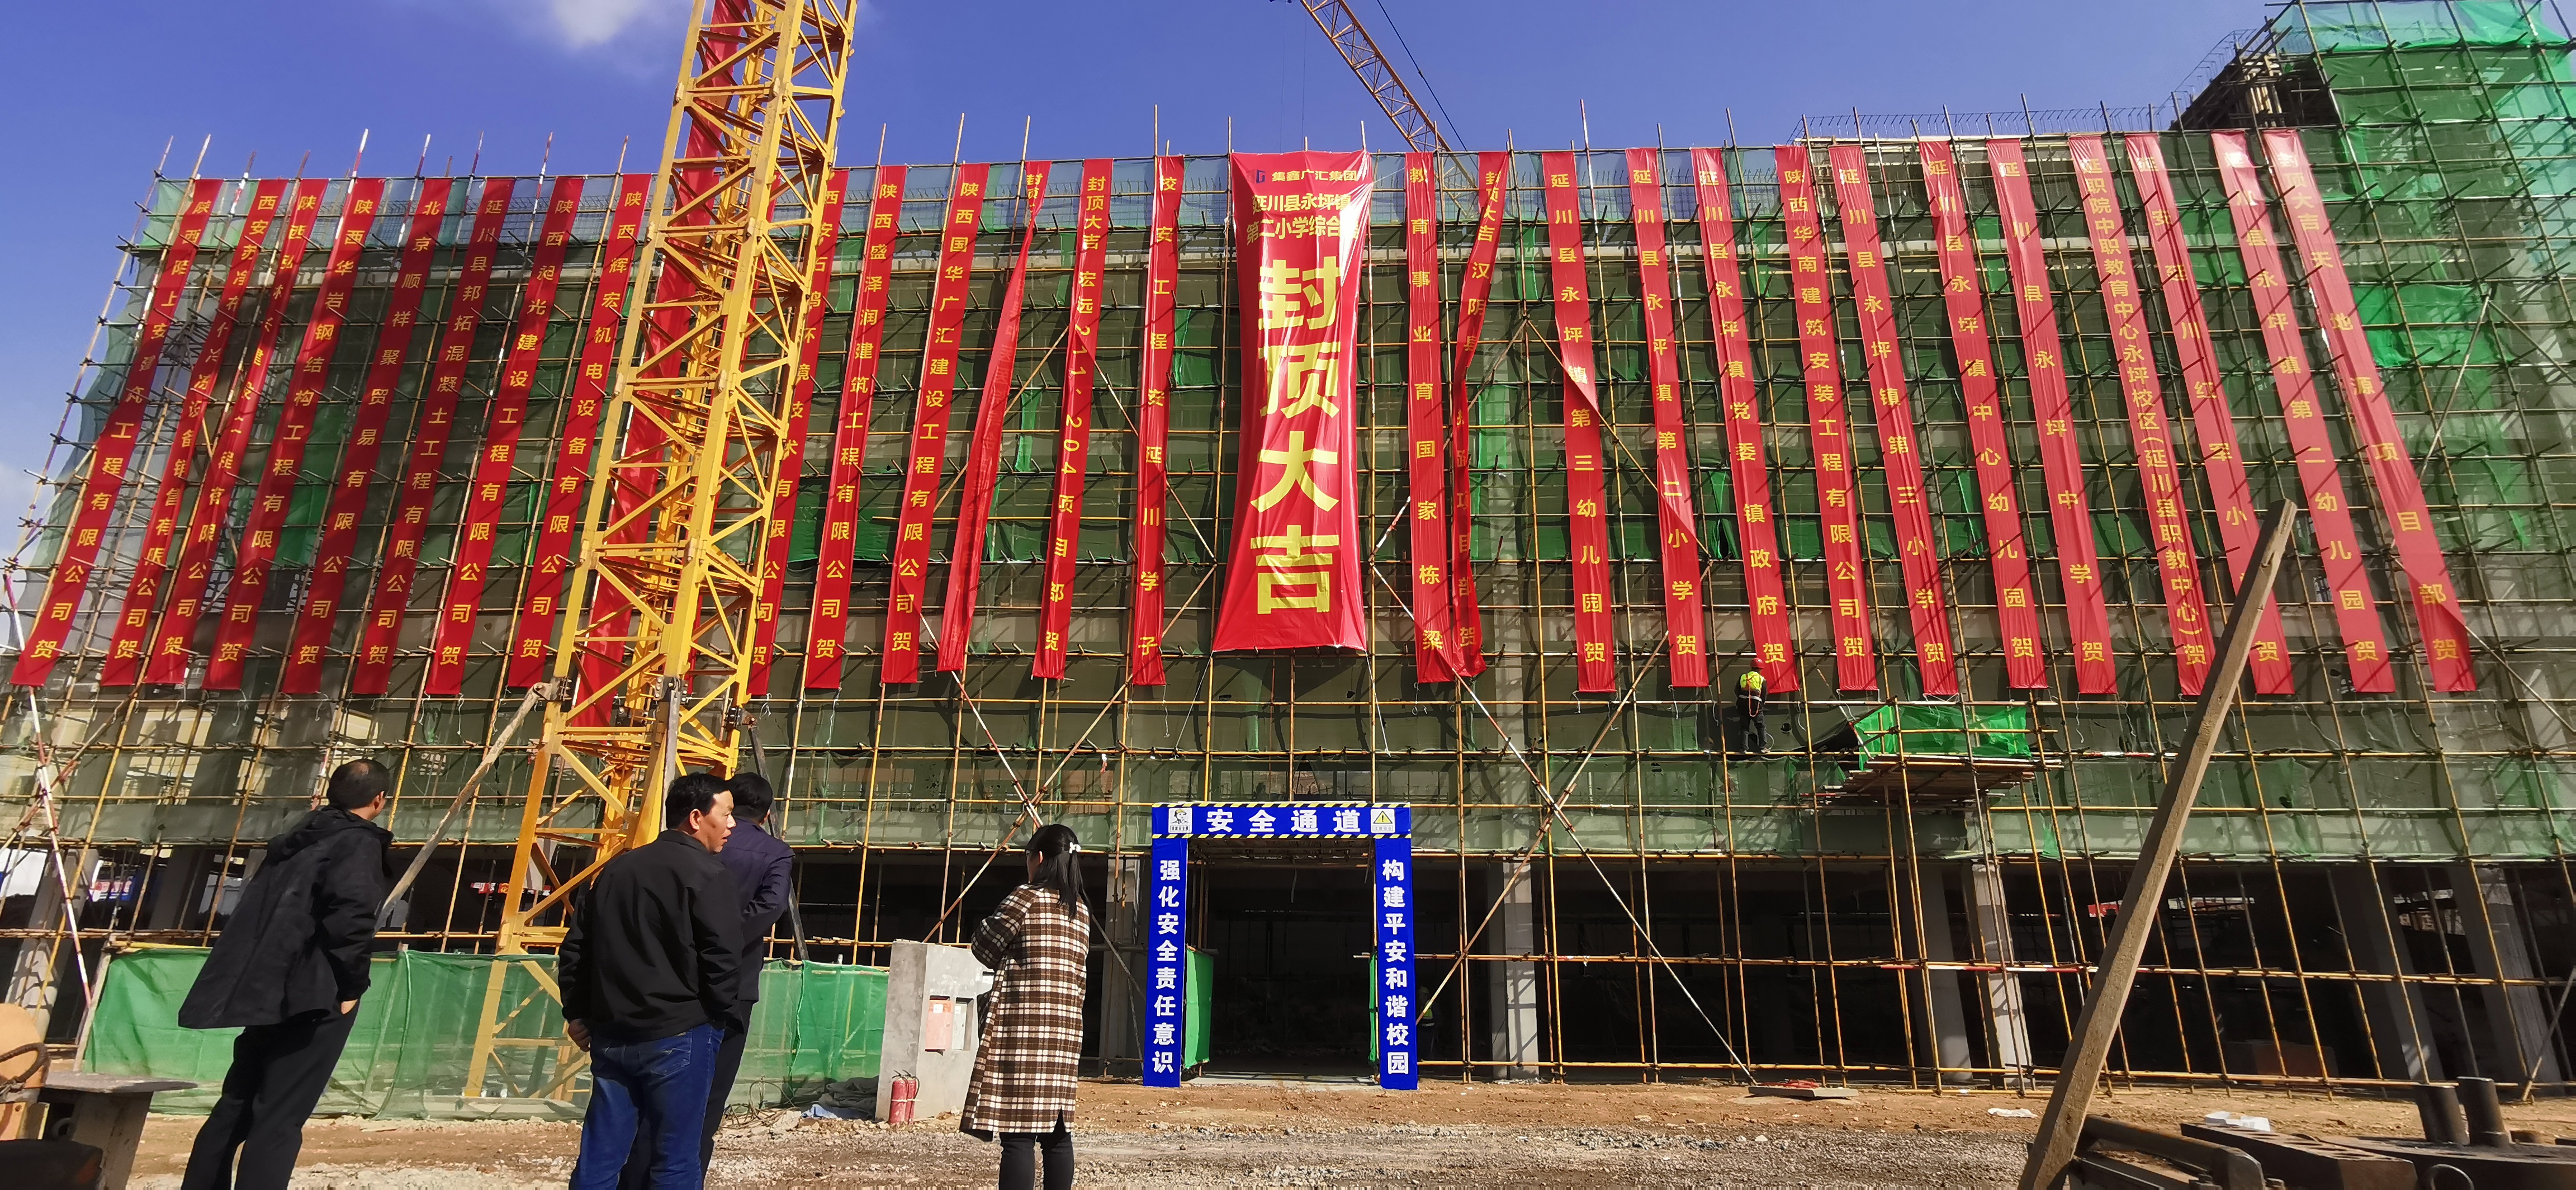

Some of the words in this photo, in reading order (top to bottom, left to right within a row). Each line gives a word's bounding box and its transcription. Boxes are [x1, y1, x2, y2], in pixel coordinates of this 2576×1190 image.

[1247, 215, 1358, 245] 第二小学综合
[1272, 169, 1357, 182] 集鑫广汇集团
[1409, 167, 1443, 650] 教育事业育国家栋梁
[1929, 160, 2034, 658] 延川县永坪镇中心幼儿园贺
[2137, 155, 2278, 661] 延安延川红军小贺
[219, 199, 373, 662] 陕西华岩钢结构工程有限公司贺
[296, 200, 442, 664] 北京顺祥聚贸易有限公司贺
[366, 199, 504, 665] 延川县邦拓混凝土工程有限公司贺
[520, 191, 643, 658] 陕西辉宏机电设备有限公司贺
[815, 183, 898, 659] 陕西盛泽润建筑工程有限公司贺
[890, 181, 979, 651] 陕西国华广汇建设工程有限公司贺
[1251, 256, 1340, 615] 封顶大吉
[1550, 173, 1606, 662] 延川县永坪镇第三幼儿园贺
[1633, 168, 1697, 655] 延川县永坪镇第二小学贺
[1785, 168, 1864, 657] 陕西华南建筑安装工程有限公司贺
[1840, 168, 1946, 662] 延川县永坪镇第三小学贺
[2000, 162, 2103, 662] 延川县永坪中学贺
[1152, 860, 1181, 1074] 强化安全责任意识
[1206, 809, 1361, 833] 安全通道
[1382, 860, 1409, 1075] 构建平安和谐校园
